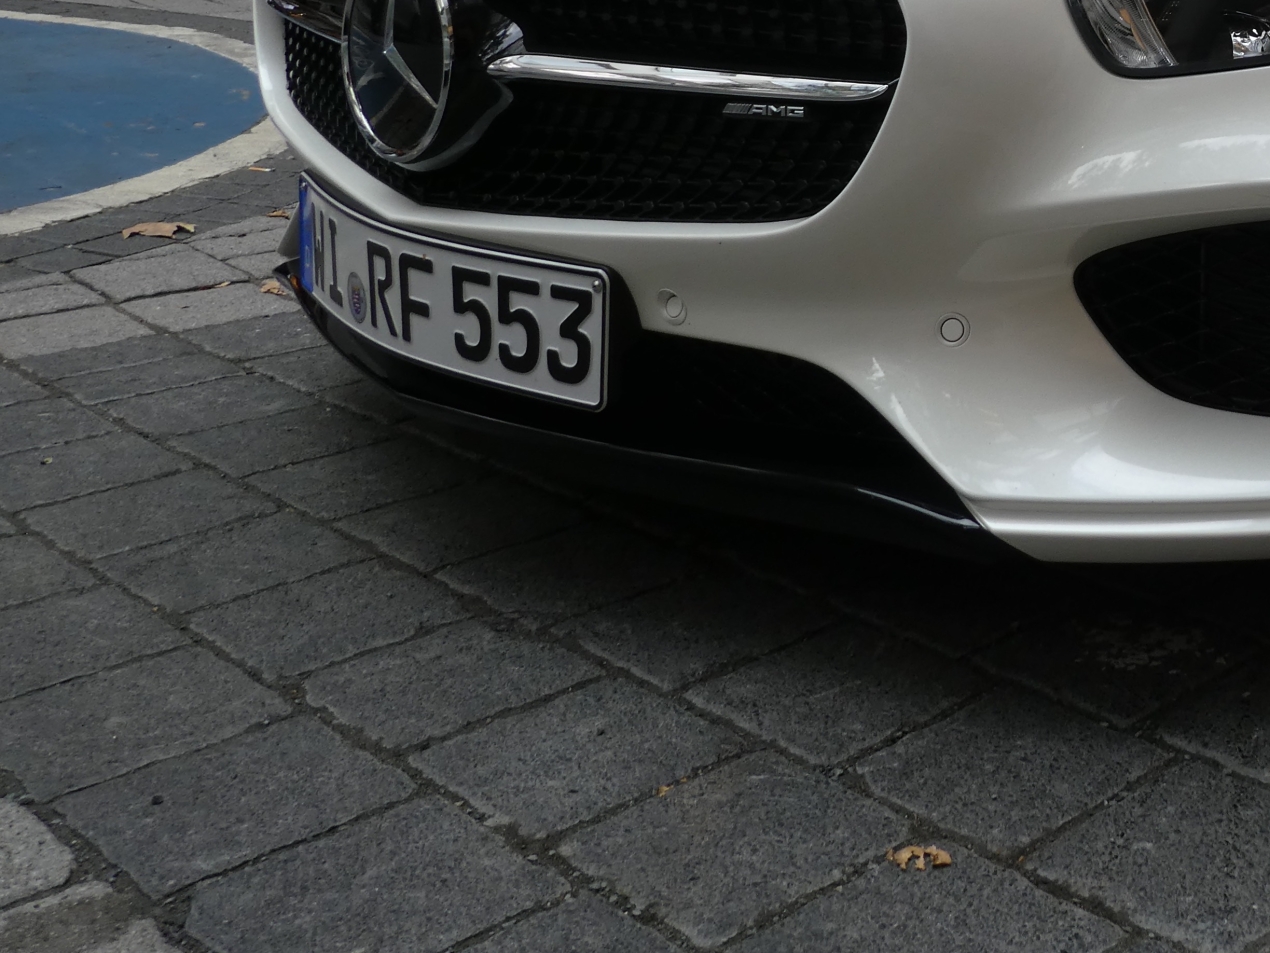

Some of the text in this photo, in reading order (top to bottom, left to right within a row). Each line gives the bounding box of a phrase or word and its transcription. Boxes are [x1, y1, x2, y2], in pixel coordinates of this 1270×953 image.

[748, 103, 805, 118] AMG
[366, 240, 434, 343] RF
[451, 265, 593, 384] 553
